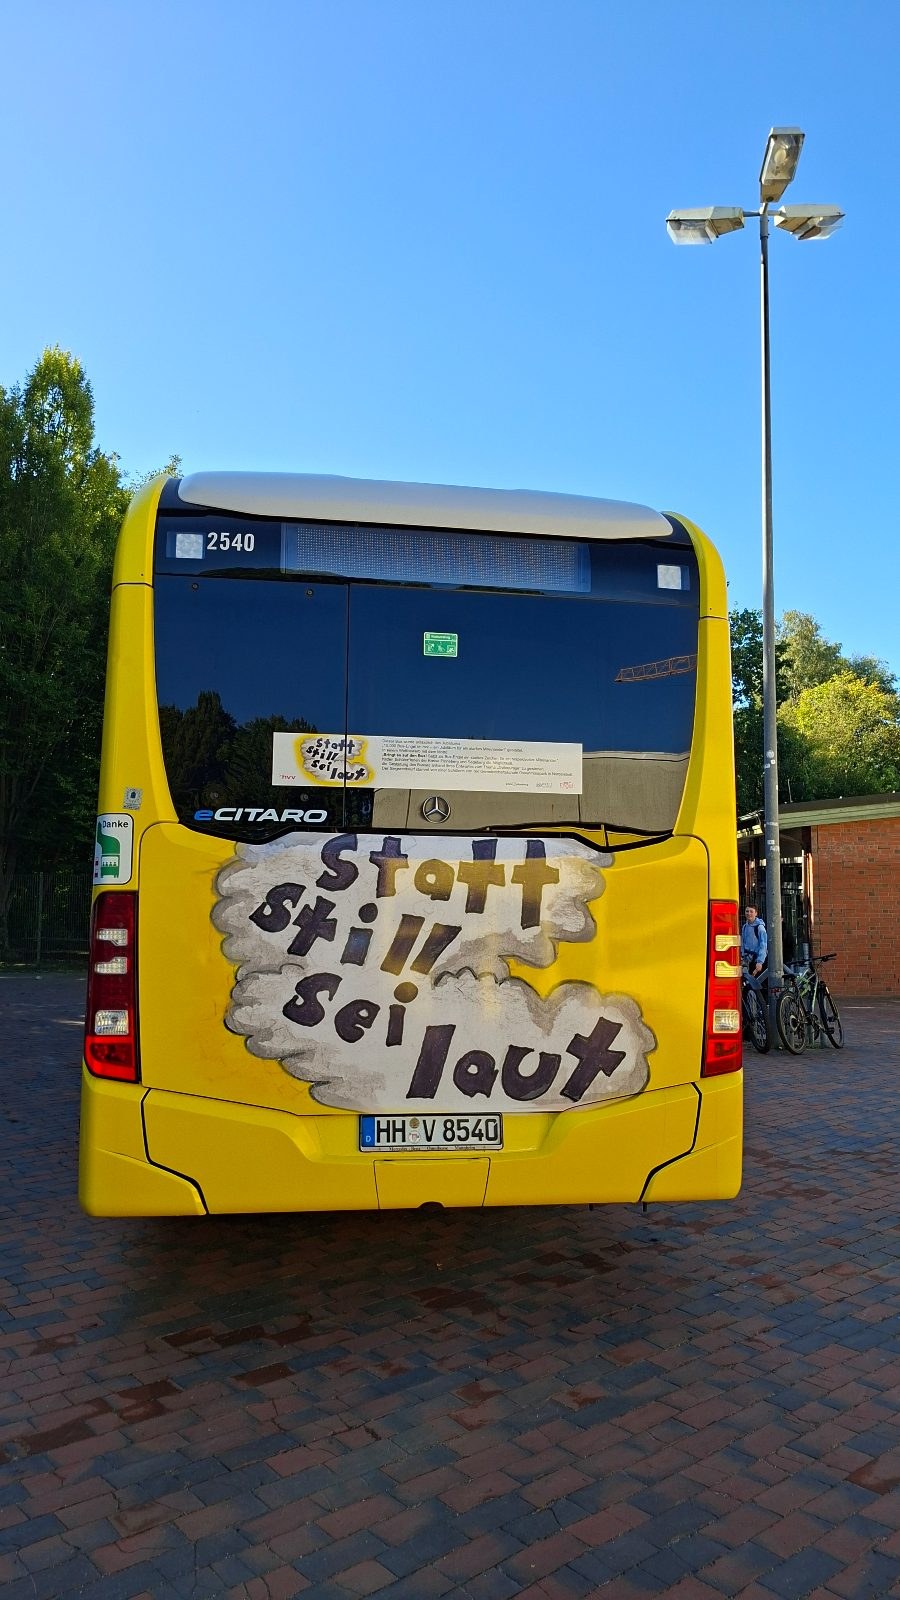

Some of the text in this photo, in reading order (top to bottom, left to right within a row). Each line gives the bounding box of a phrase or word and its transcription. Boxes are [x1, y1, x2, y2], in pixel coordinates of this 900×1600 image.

[206, 532, 255, 552] 2540
[306, 746, 339, 760] Still
[316, 738, 355, 754] Statt
[330, 768, 365, 780] laut
[102, 820, 129, 828] Danke
[194, 808, 328, 822] eCITARO
[316, 834, 560, 930] Statt
[249, 883, 462, 976] Still
[406, 1017, 627, 1101] laut
[376, 1118, 499, 1143] HH V 8540
